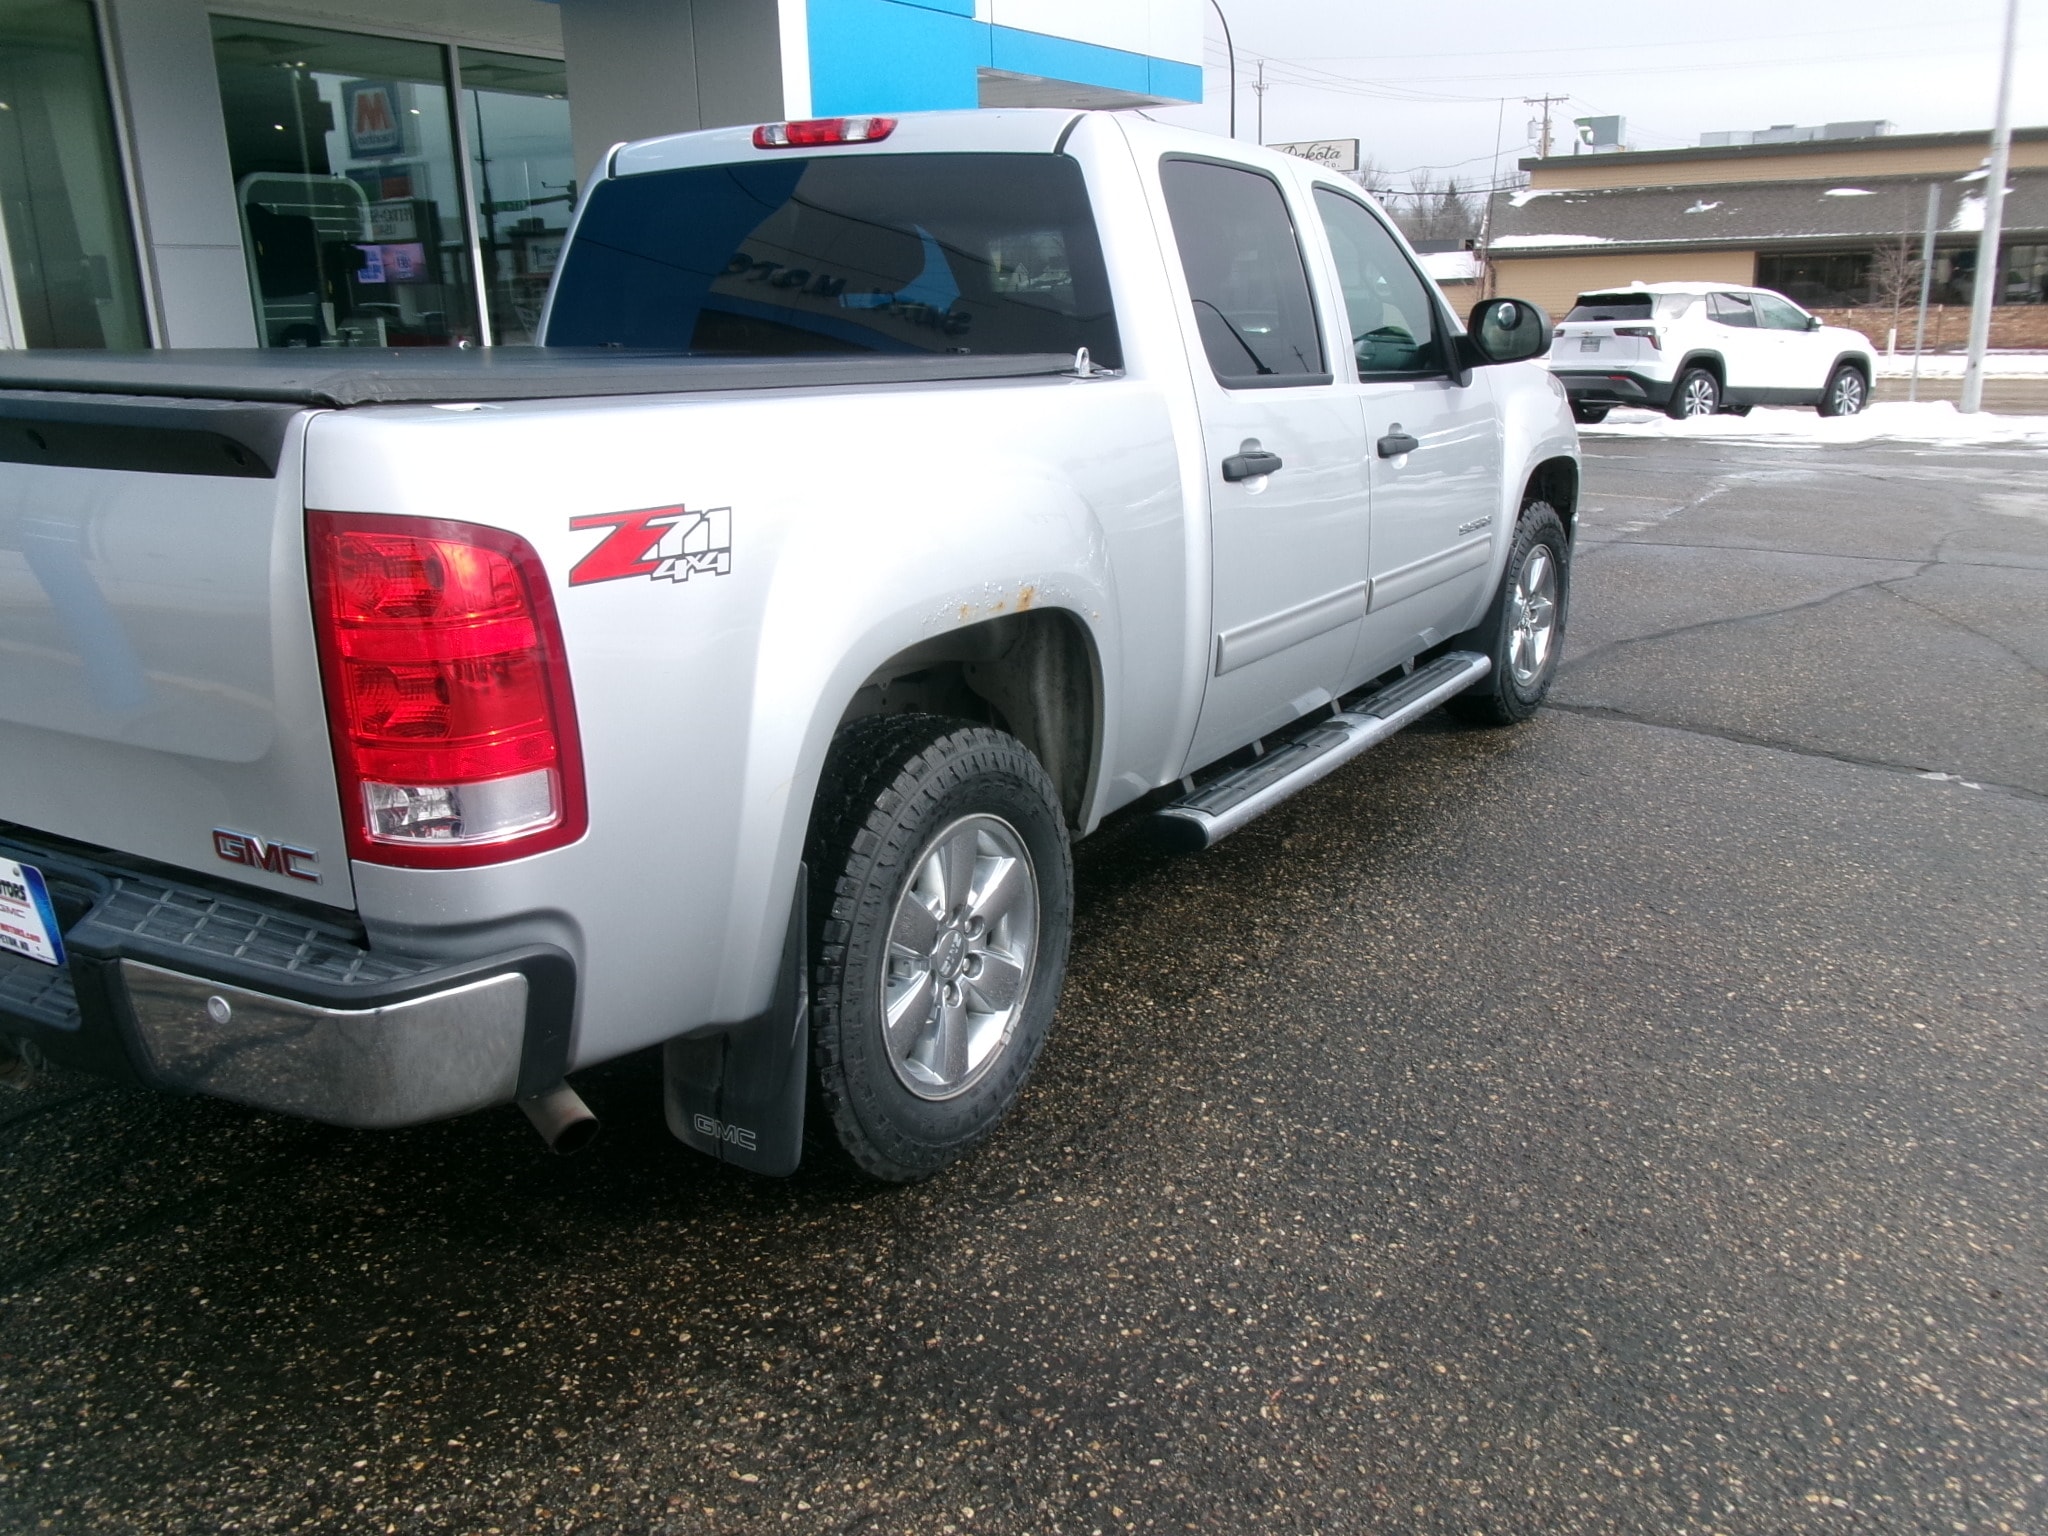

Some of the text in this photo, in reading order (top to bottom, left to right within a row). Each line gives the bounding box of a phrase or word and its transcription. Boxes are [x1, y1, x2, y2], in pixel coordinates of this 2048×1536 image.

[1282, 143, 1341, 161] Dakota
[567, 503, 732, 587] Z71
[212, 828, 323, 885] GMC
[693, 1113, 757, 1151] GMC
